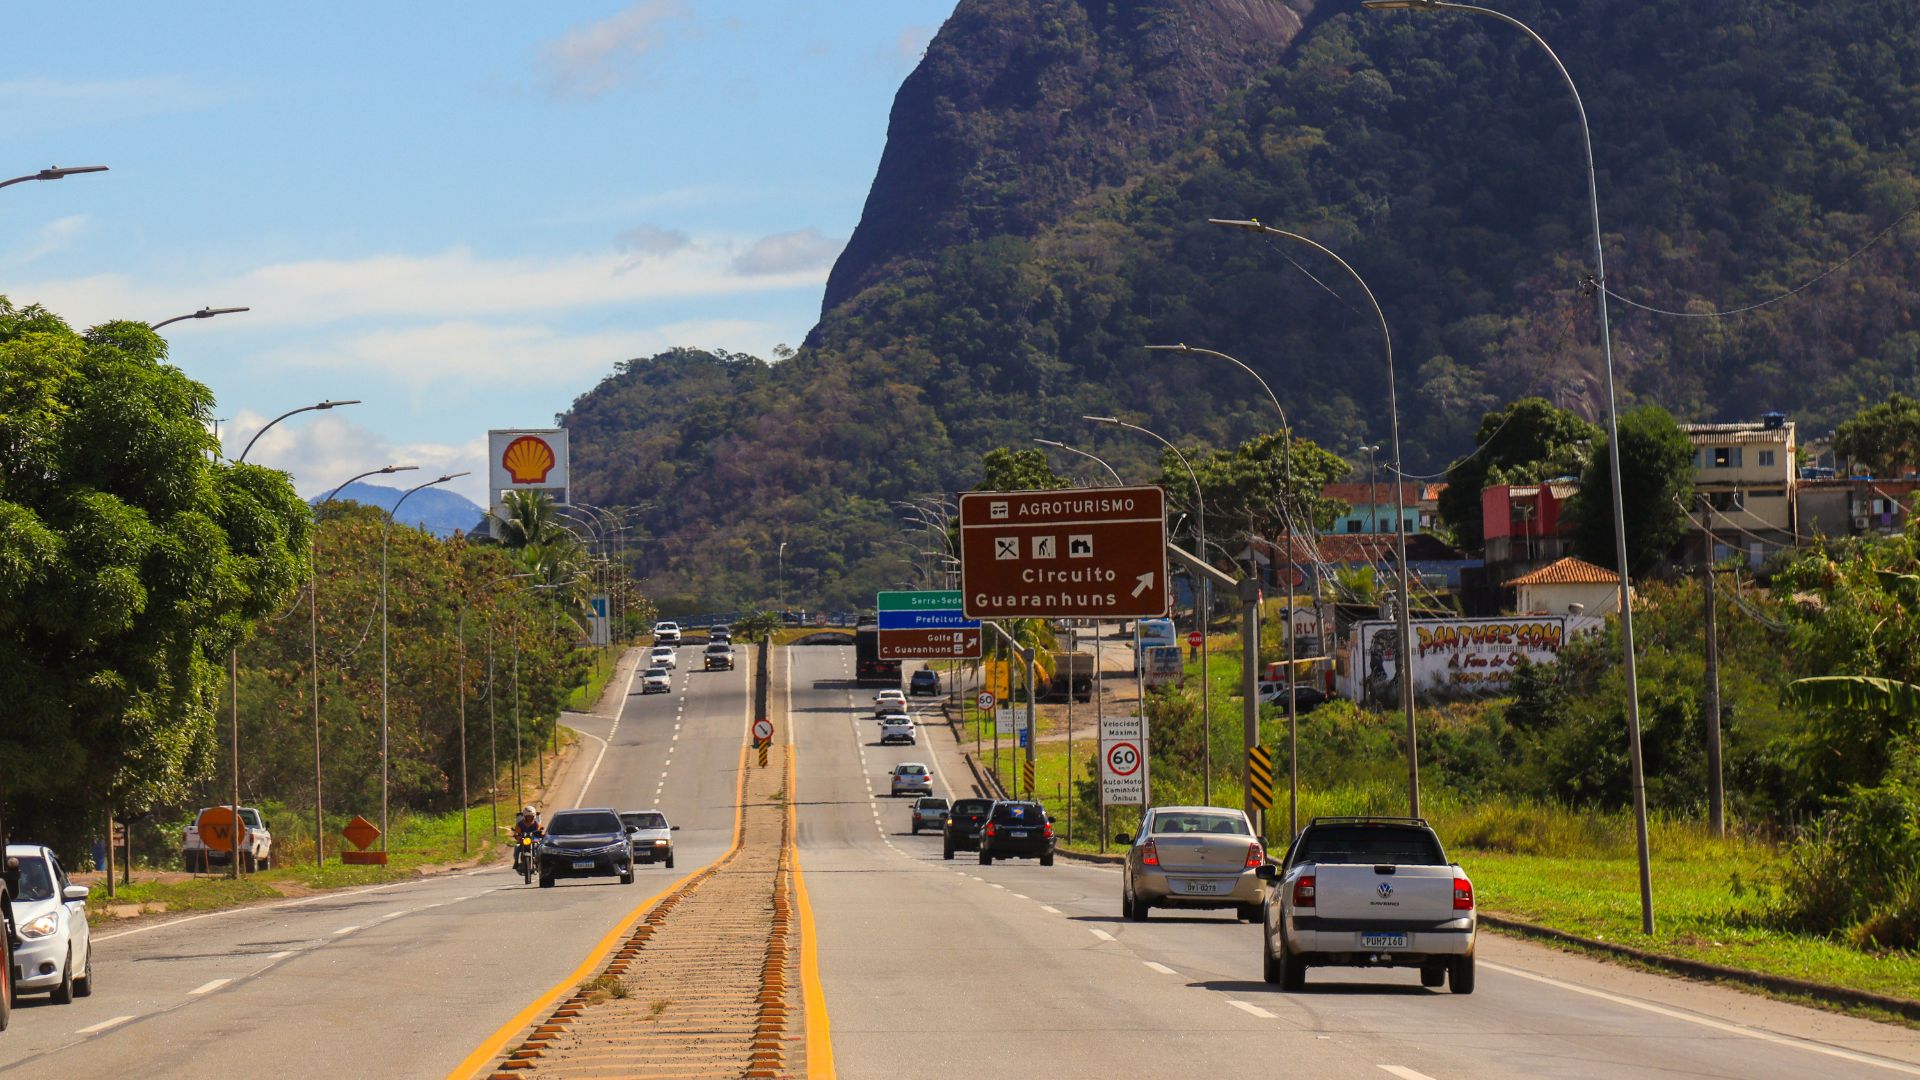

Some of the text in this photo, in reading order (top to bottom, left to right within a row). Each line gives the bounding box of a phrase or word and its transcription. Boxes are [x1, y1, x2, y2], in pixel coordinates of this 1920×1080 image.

[1018, 499, 1134, 516] AGROTURISMO
[1022, 567, 1116, 583] Circuito
[975, 592, 1117, 608] Guaranhuns
[927, 634, 951, 642] Golfe
[979, 695, 992, 704] 60
[1113, 750, 1135, 764] 60
